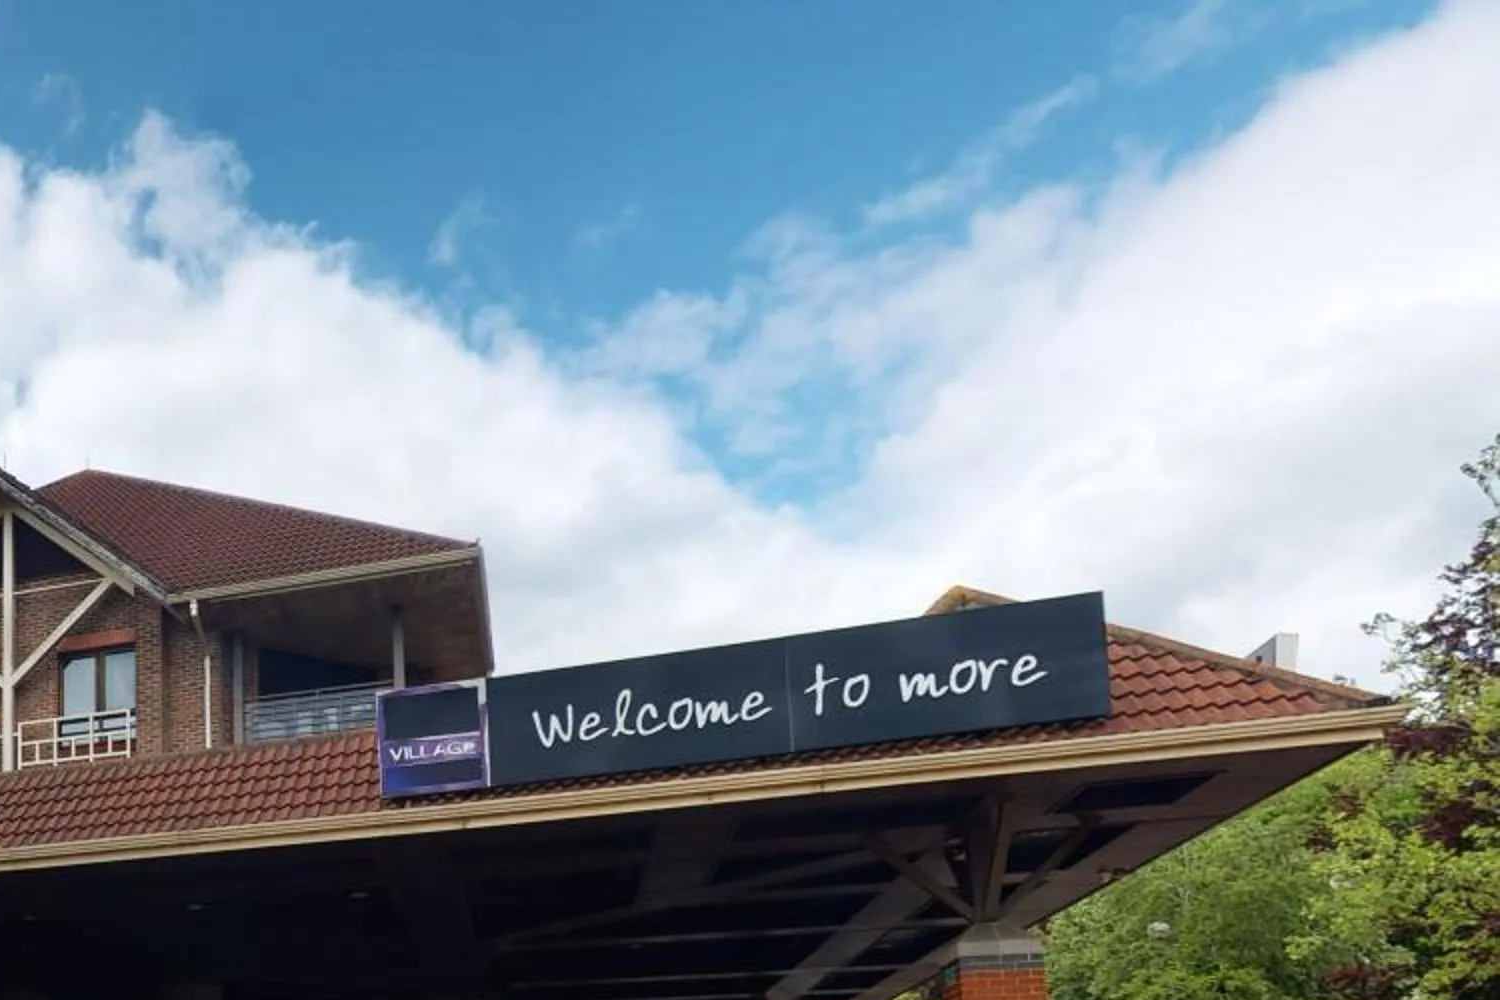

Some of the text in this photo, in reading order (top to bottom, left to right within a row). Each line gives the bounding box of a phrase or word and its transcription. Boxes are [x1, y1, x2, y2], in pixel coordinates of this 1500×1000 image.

[532, 653, 1049, 748] Welcome to more
